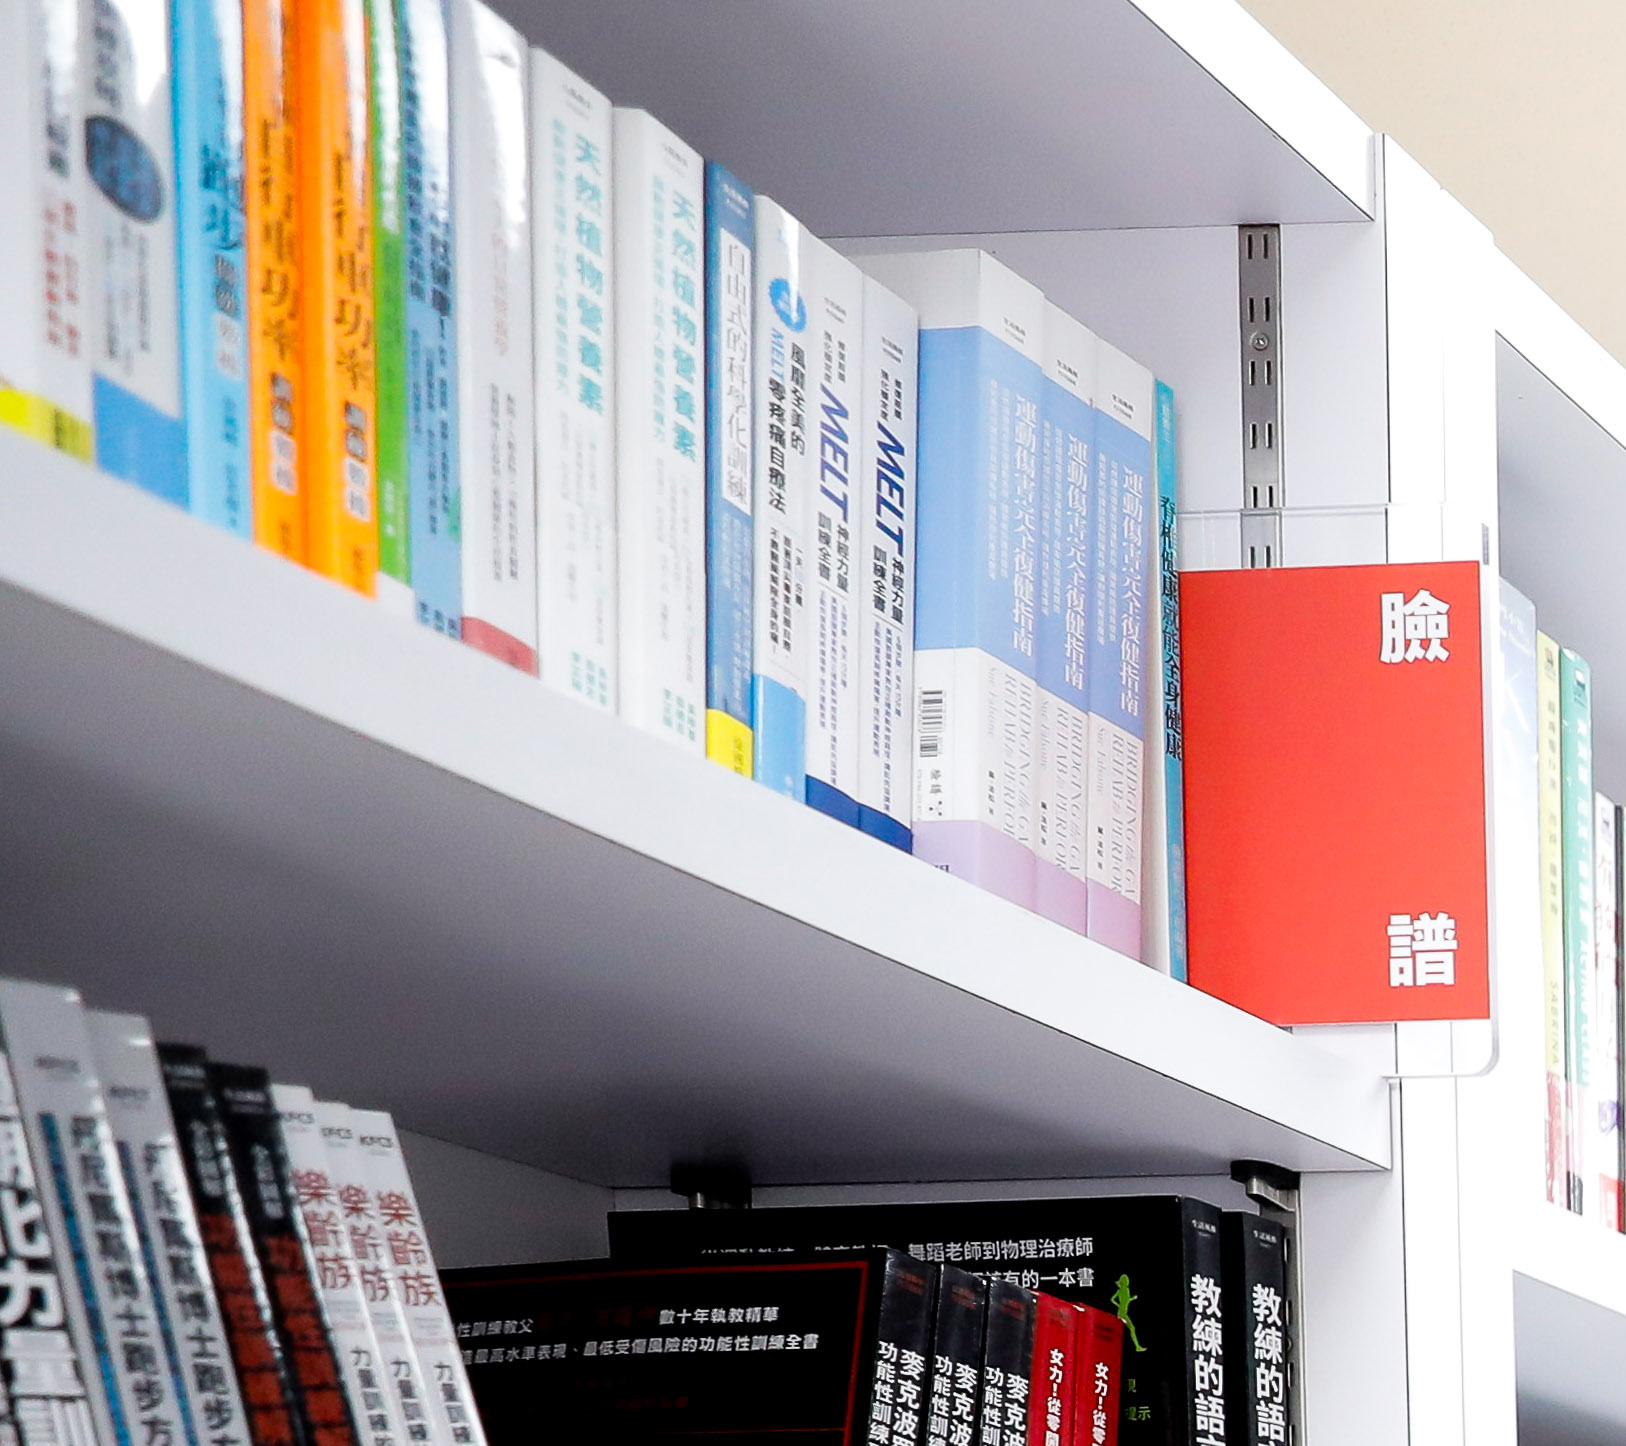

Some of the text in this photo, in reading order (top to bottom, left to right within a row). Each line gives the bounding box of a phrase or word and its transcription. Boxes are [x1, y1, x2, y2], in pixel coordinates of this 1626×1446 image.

[820, 383, 849, 523] MELT
[875, 421, 905, 557] MELT
[872, 544, 887, 614] 訓練全書
[891, 556, 906, 626] 神經力量
[1380, 590, 1458, 988] 臉譜
[377, 1192, 443, 1309] 樂齡族
[658, 1306, 780, 1326] 數十年執教精華
